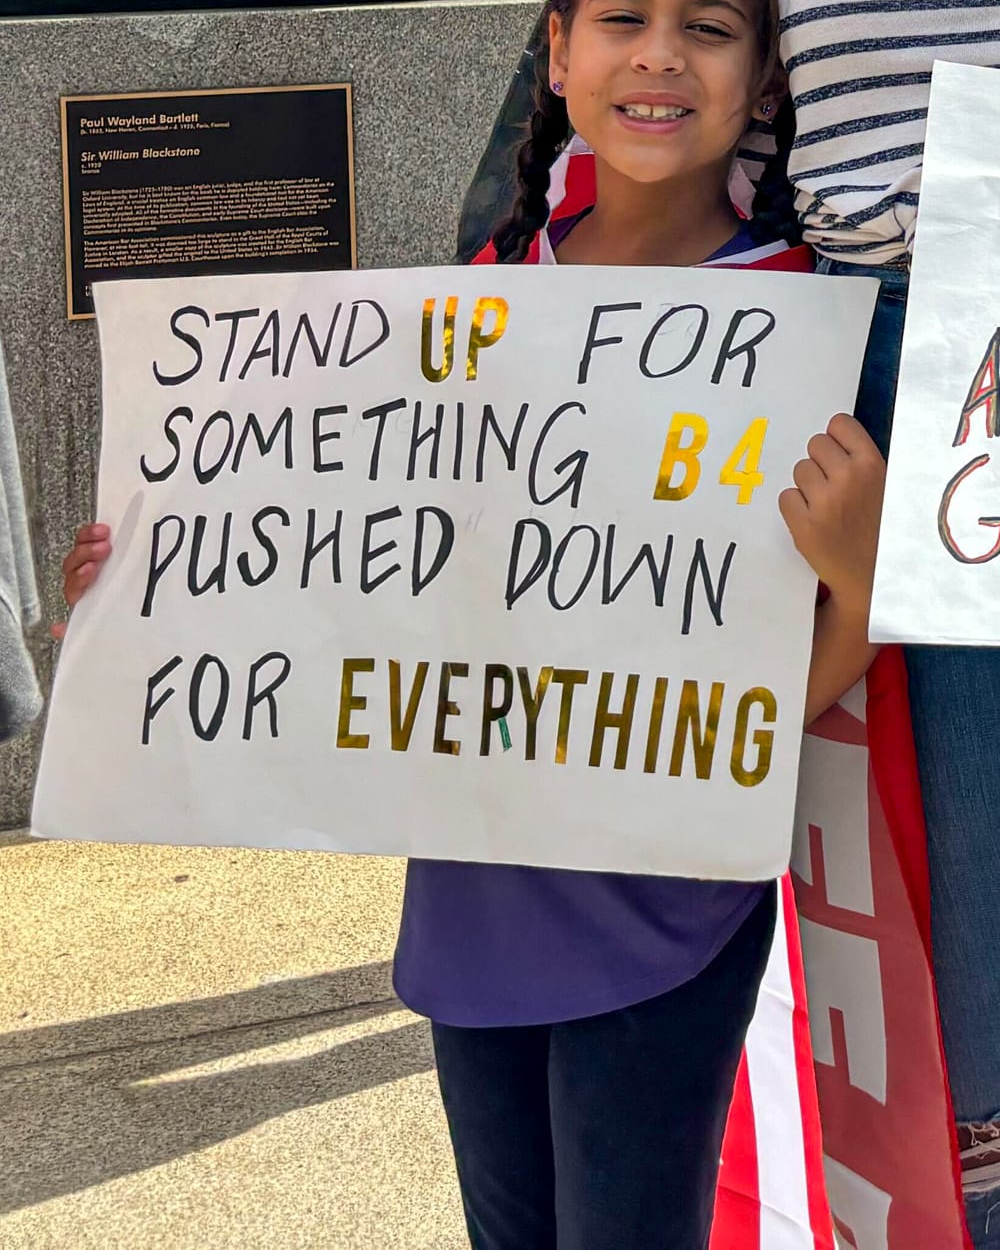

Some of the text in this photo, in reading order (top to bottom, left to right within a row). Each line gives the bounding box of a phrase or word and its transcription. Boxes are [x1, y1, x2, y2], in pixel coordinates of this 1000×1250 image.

[80, 113, 199, 128] Paul Wayland Bartlett
[81, 147, 200, 162] Sir William Blackstone
[152, 295, 776, 388] STAND UP FOR
[140, 398, 769, 508] SOMETHING B4
[140, 506, 737, 635] PUSHED DOWN
[141, 651, 779, 788] FOR EVERYTHING
